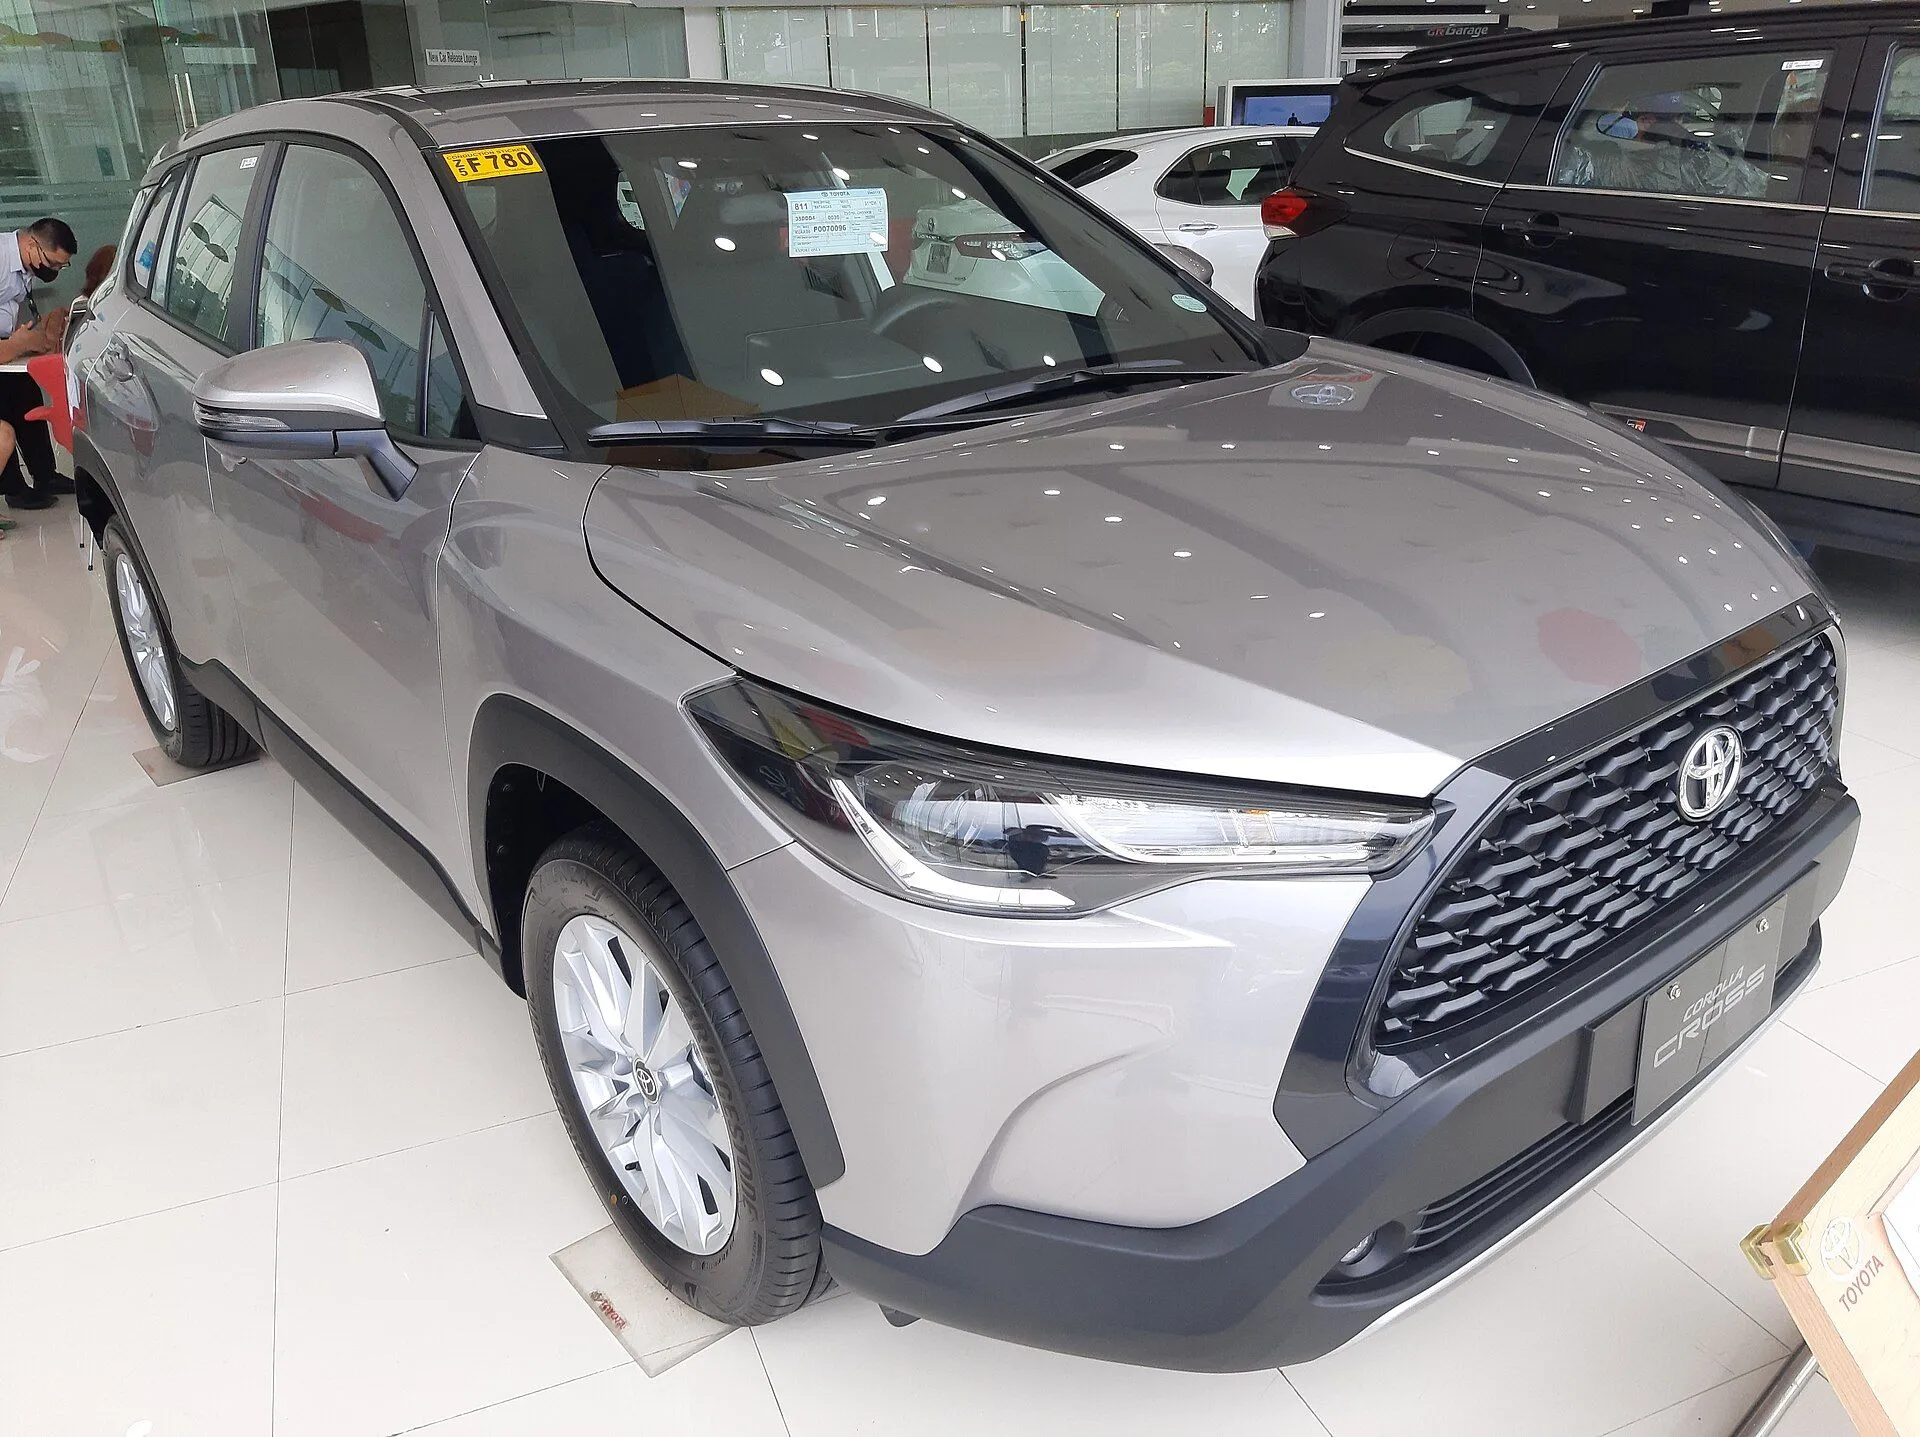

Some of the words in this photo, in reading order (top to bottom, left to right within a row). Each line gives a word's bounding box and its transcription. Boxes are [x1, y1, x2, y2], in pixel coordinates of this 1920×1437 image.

[1445, 24, 1489, 38] Garage
[428, 51, 438, 62] New
[447, 51, 463, 63] Release
[463, 51, 478, 66] Lounge
[795, 203, 808, 211] 811
[1682, 965, 1745, 1023] COROLLA
[1653, 964, 1766, 1069] CROSS
[1838, 1255, 1885, 1312] TOYOTA
[601, 1299, 627, 1331] TOYOTA
